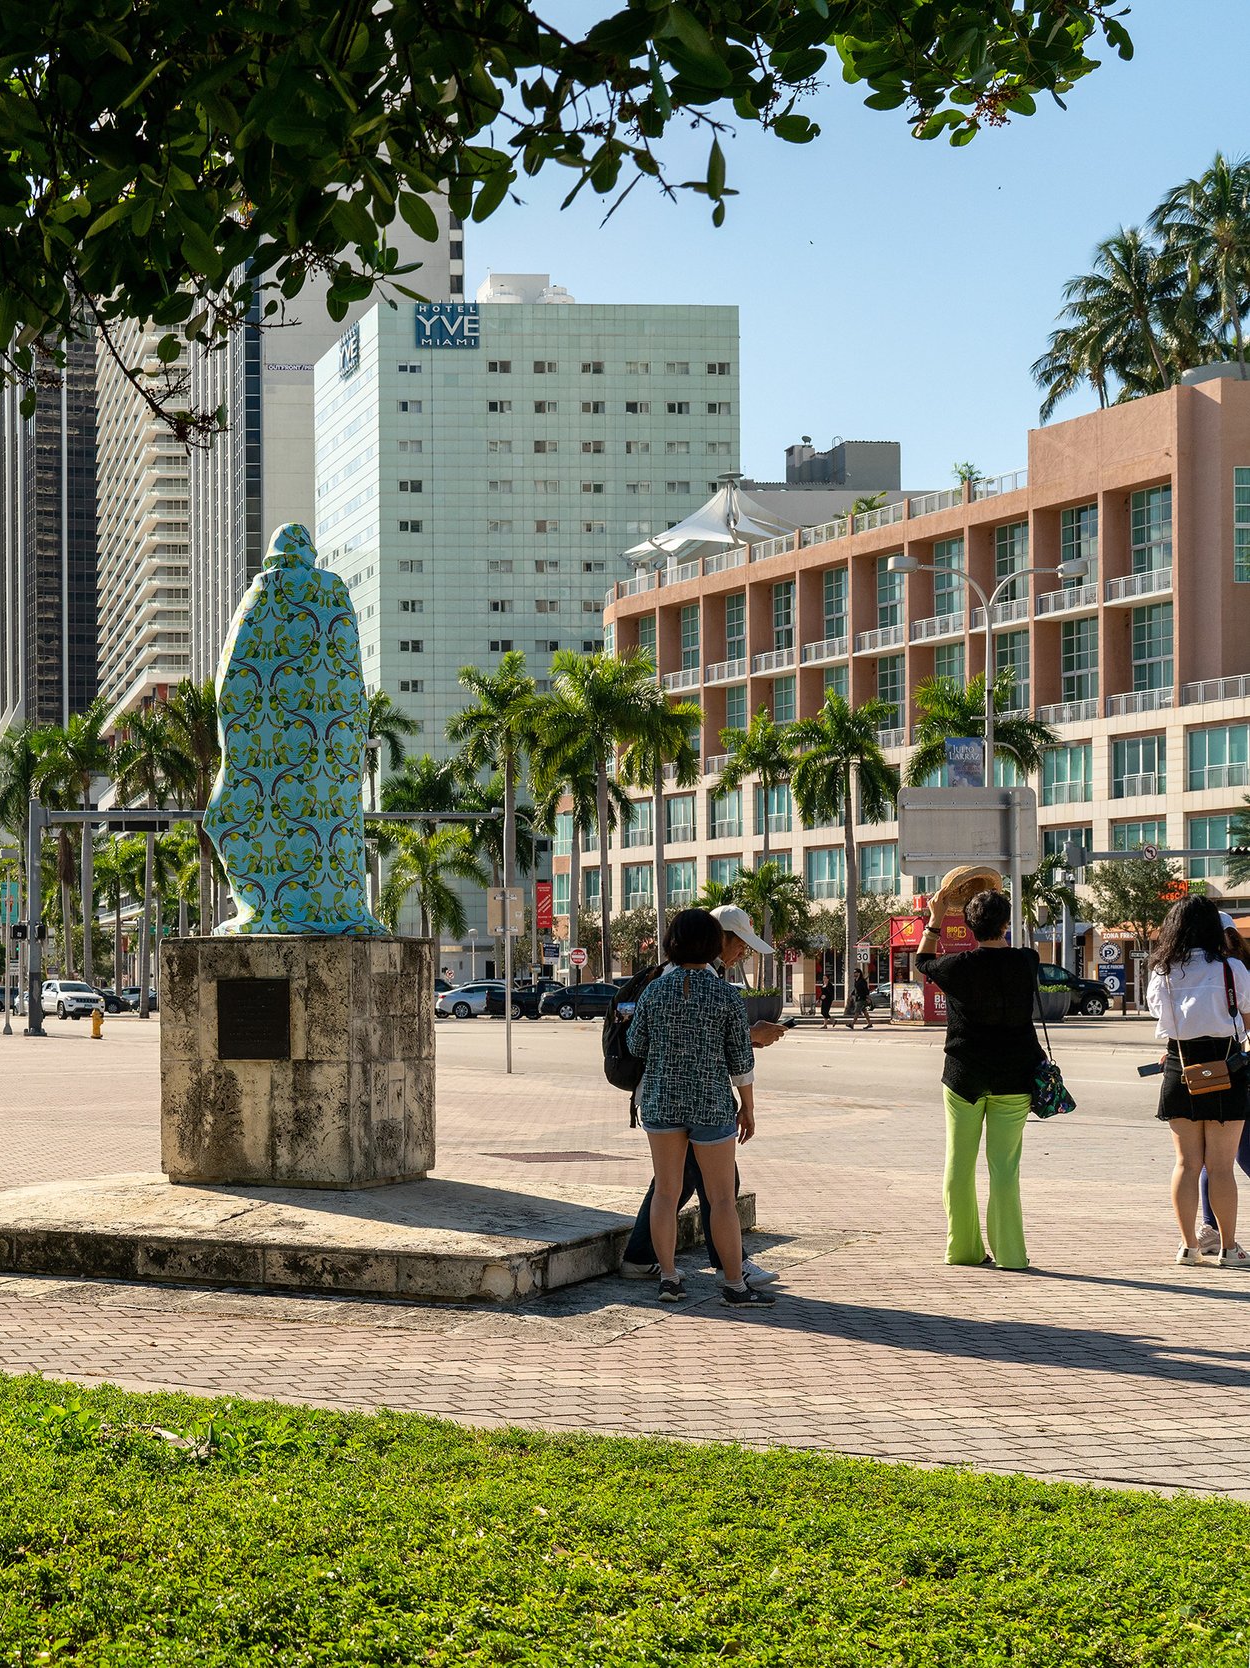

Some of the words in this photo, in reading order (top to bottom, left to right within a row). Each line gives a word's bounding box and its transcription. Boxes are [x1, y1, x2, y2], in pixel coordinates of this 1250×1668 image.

[416, 315, 480, 336] YVE
[856, 953, 869, 961] 30
[1108, 978, 1115, 989] 3
